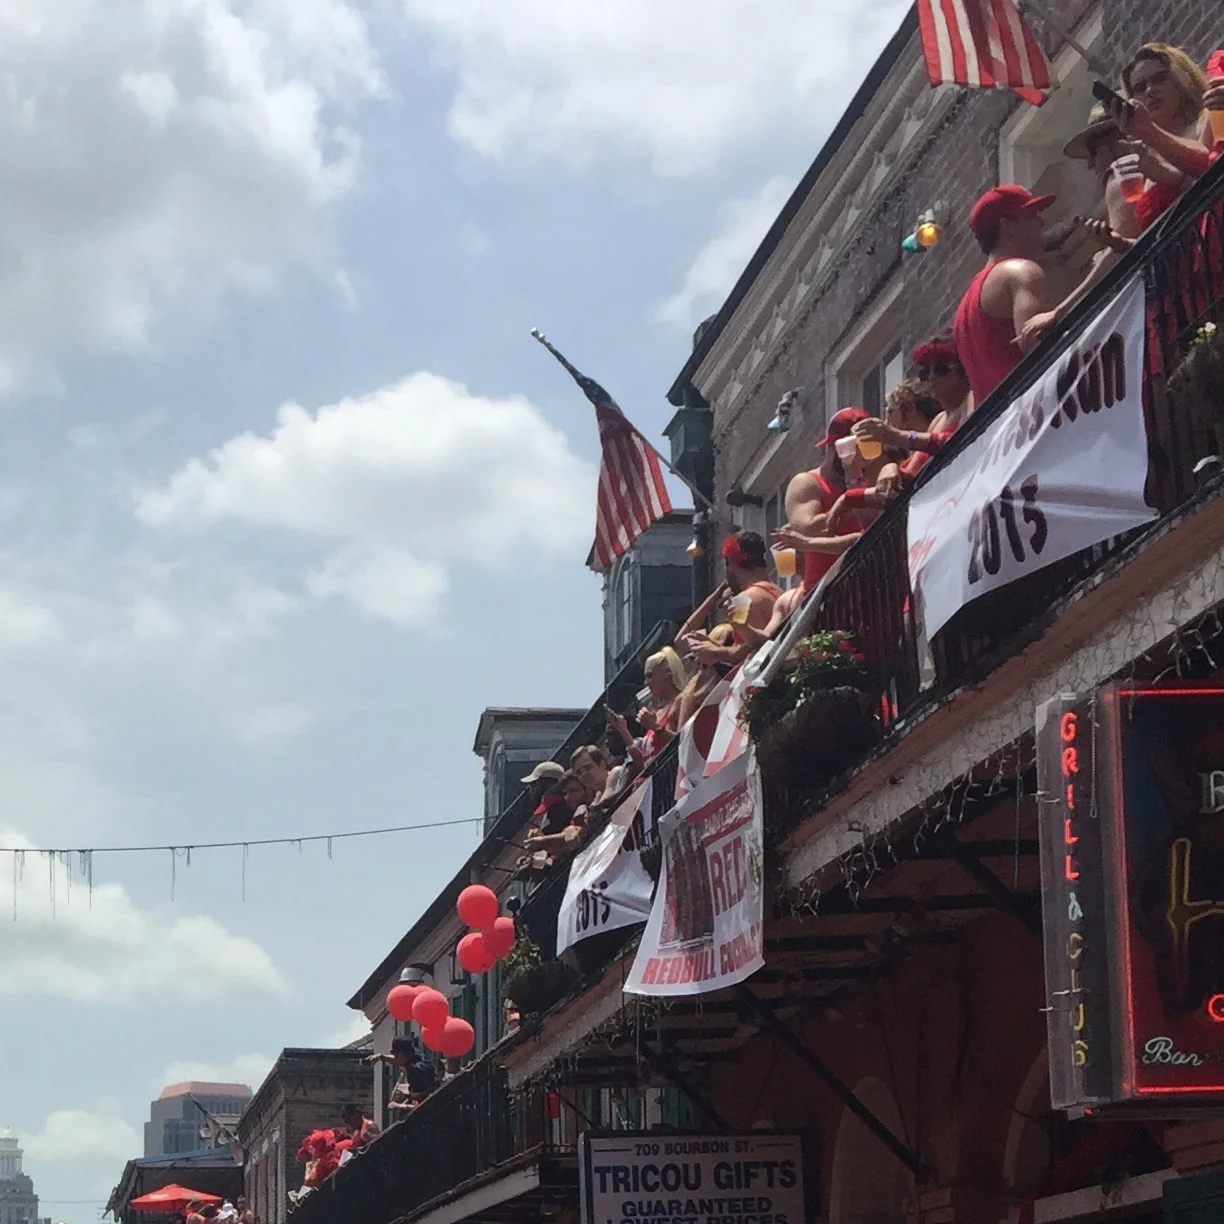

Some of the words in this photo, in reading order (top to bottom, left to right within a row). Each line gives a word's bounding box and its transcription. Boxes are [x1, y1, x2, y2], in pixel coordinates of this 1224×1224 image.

[967, 474, 1048, 585] 2015
[1060, 711, 1080, 881] GRILL
[641, 950, 716, 985] REDBULL
[1142, 1036, 1203, 1066] Bar
[635, 1143, 659, 1156] 709
[665, 1141, 729, 1156] BOURBON
[734, 1140, 754, 1153] ST.
[594, 1162, 702, 1194] TRICOU
[713, 1159, 797, 1190] GIFTS
[621, 1196, 773, 1218] GUARANTEED
